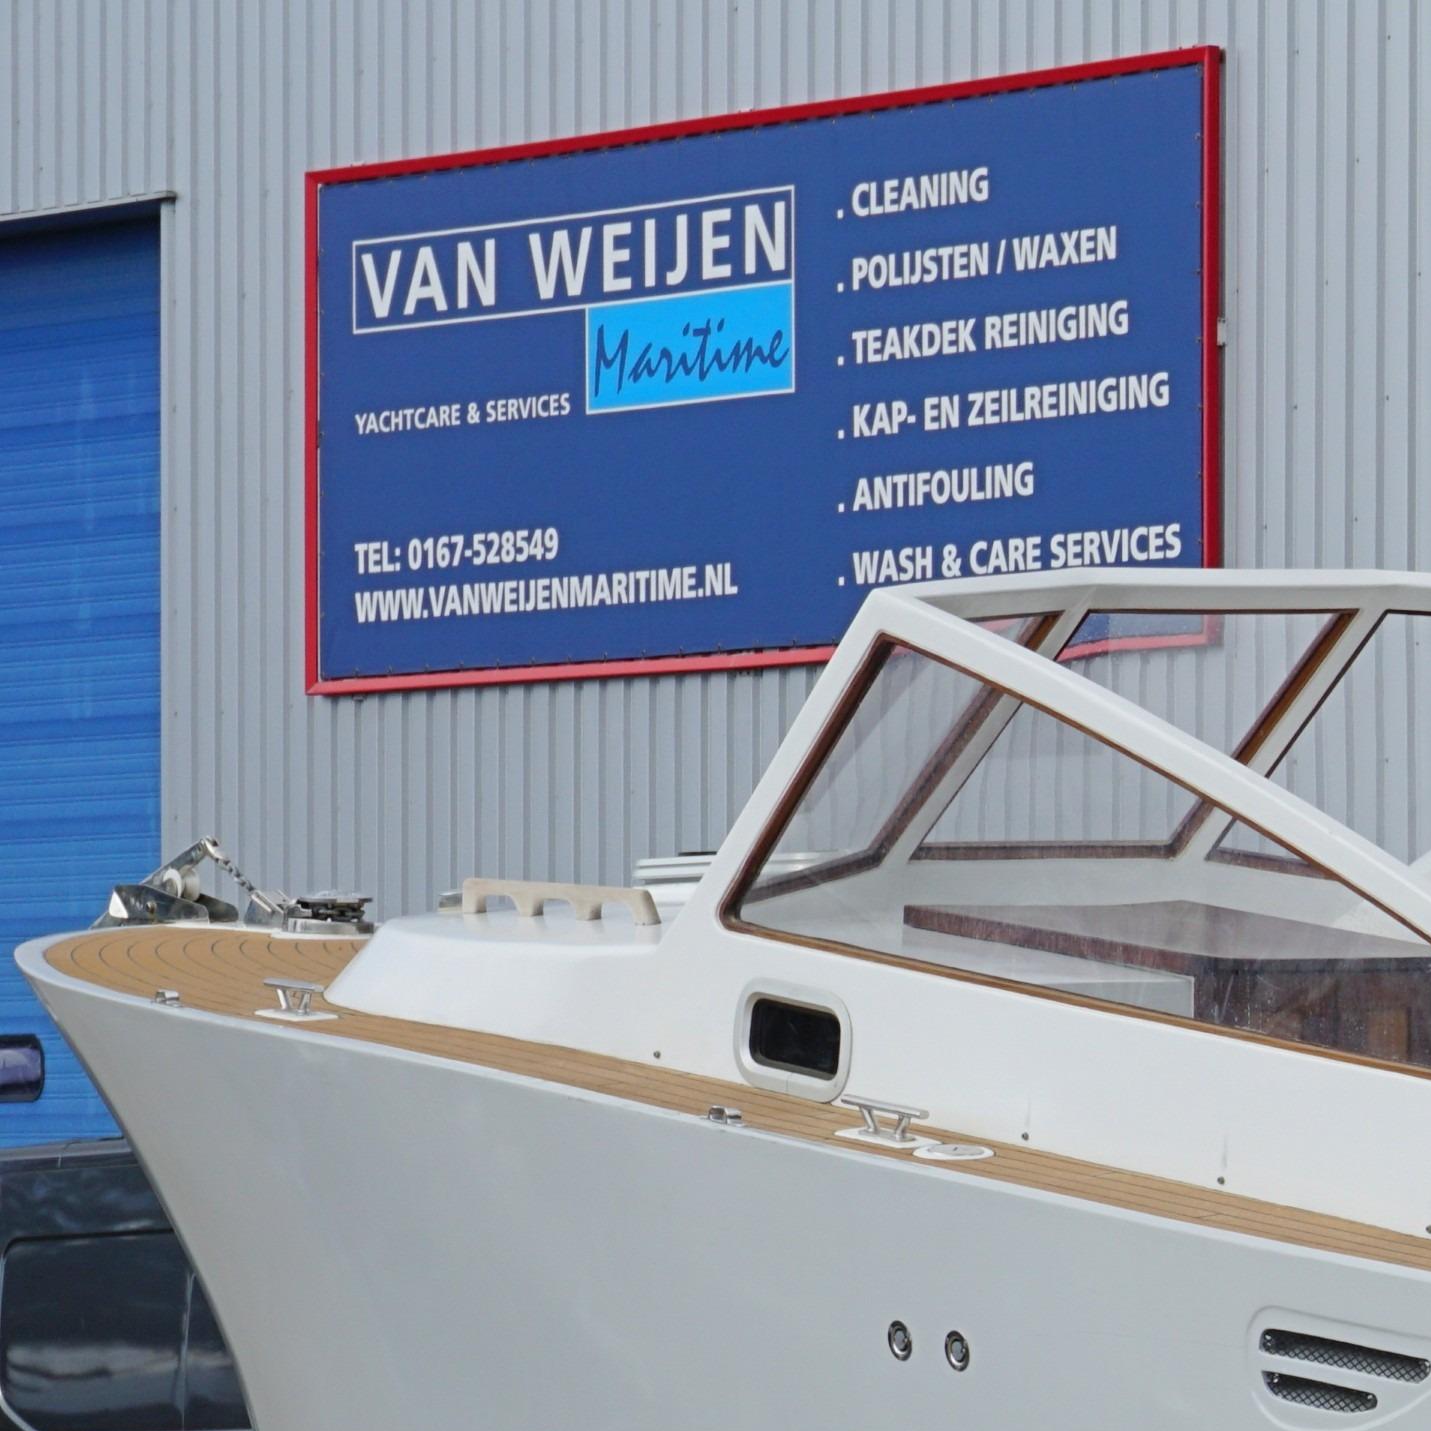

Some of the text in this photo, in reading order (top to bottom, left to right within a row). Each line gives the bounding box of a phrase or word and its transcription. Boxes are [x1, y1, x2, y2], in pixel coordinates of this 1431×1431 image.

[852, 167, 988, 216] CLEANING
[362, 201, 785, 318] VAN WEIJEN
[853, 226, 1116, 290] POLIJSTEN / WAXEN
[595, 316, 790, 398] Maritime
[852, 300, 1128, 363] TEAKDEK REINIGING
[355, 393, 570, 434] YACHTCARE & SERVICES
[854, 372, 1169, 437] KAP- EN ZEILREINIGING
[853, 462, 1033, 511] ANTIFOULING
[355, 528, 558, 574] TEL: 0167-528549
[853, 523, 1181, 584] WASH & CARE SERVICES
[355, 563, 738, 623] WWW.VANWEIJENMARITIME.NL
